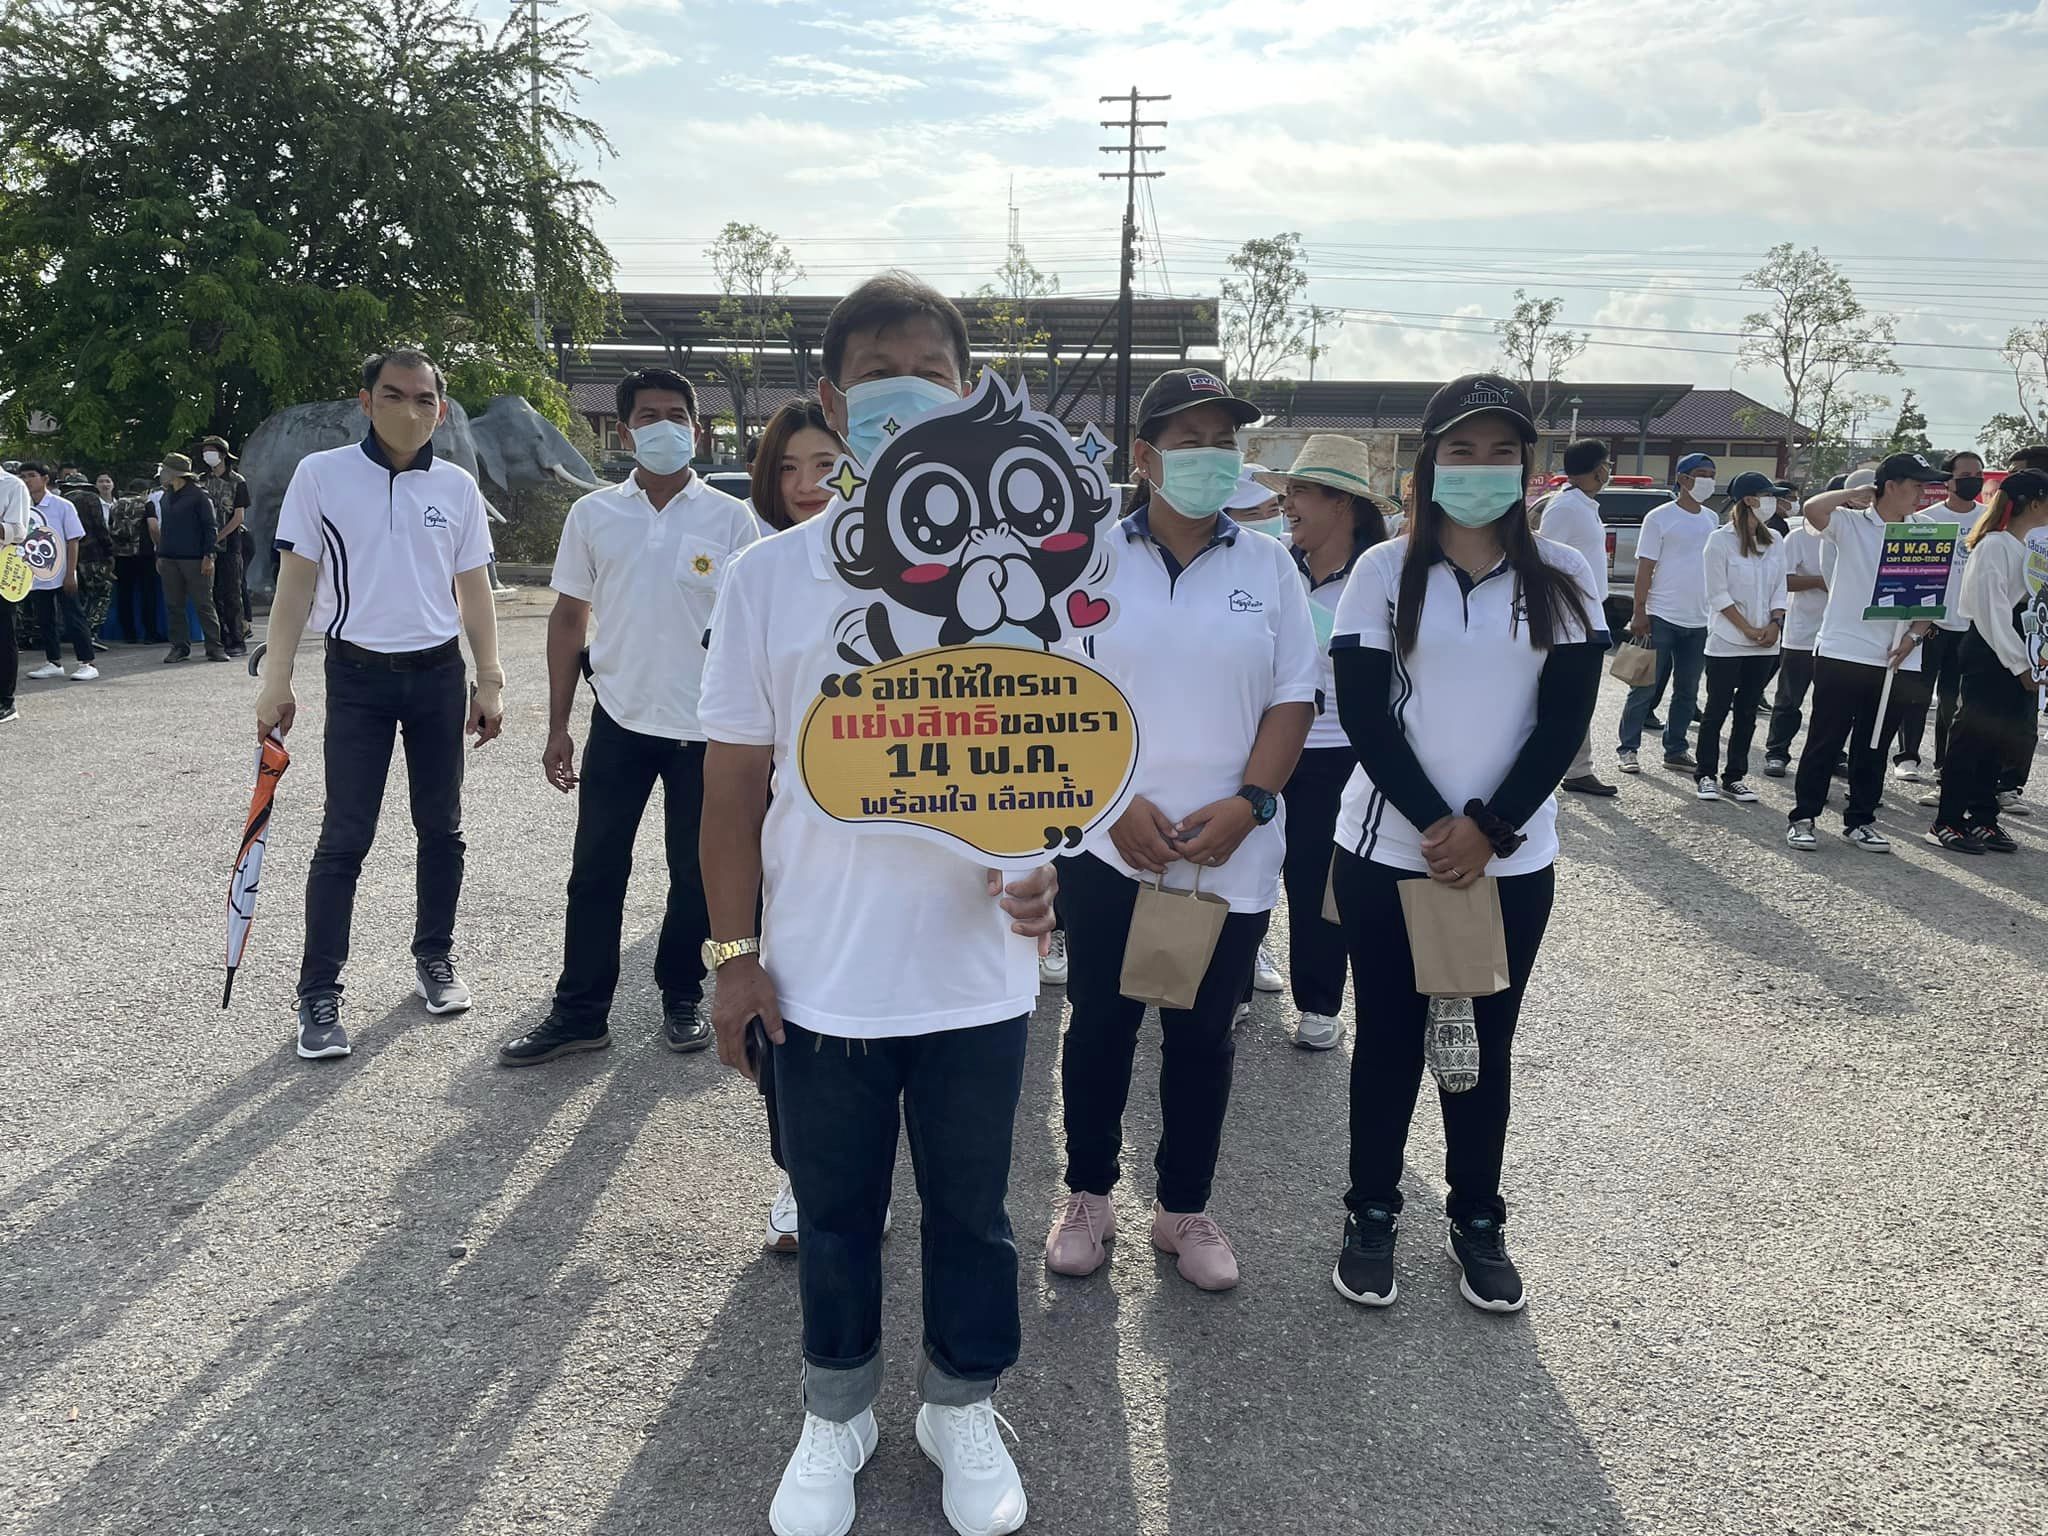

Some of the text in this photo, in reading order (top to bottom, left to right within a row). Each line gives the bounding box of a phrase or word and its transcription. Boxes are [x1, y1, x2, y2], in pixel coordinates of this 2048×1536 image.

[1460, 391, 1500, 406] PUMA
[1887, 542, 1900, 554] 14
[1935, 542, 1951, 554] 66
[872, 663, 1078, 700] อย่าให้ใครมา
[886, 742, 1069, 778] 14 พ.ค.
[861, 776, 1094, 815] พร้อมใจ เลือกตั้ง
